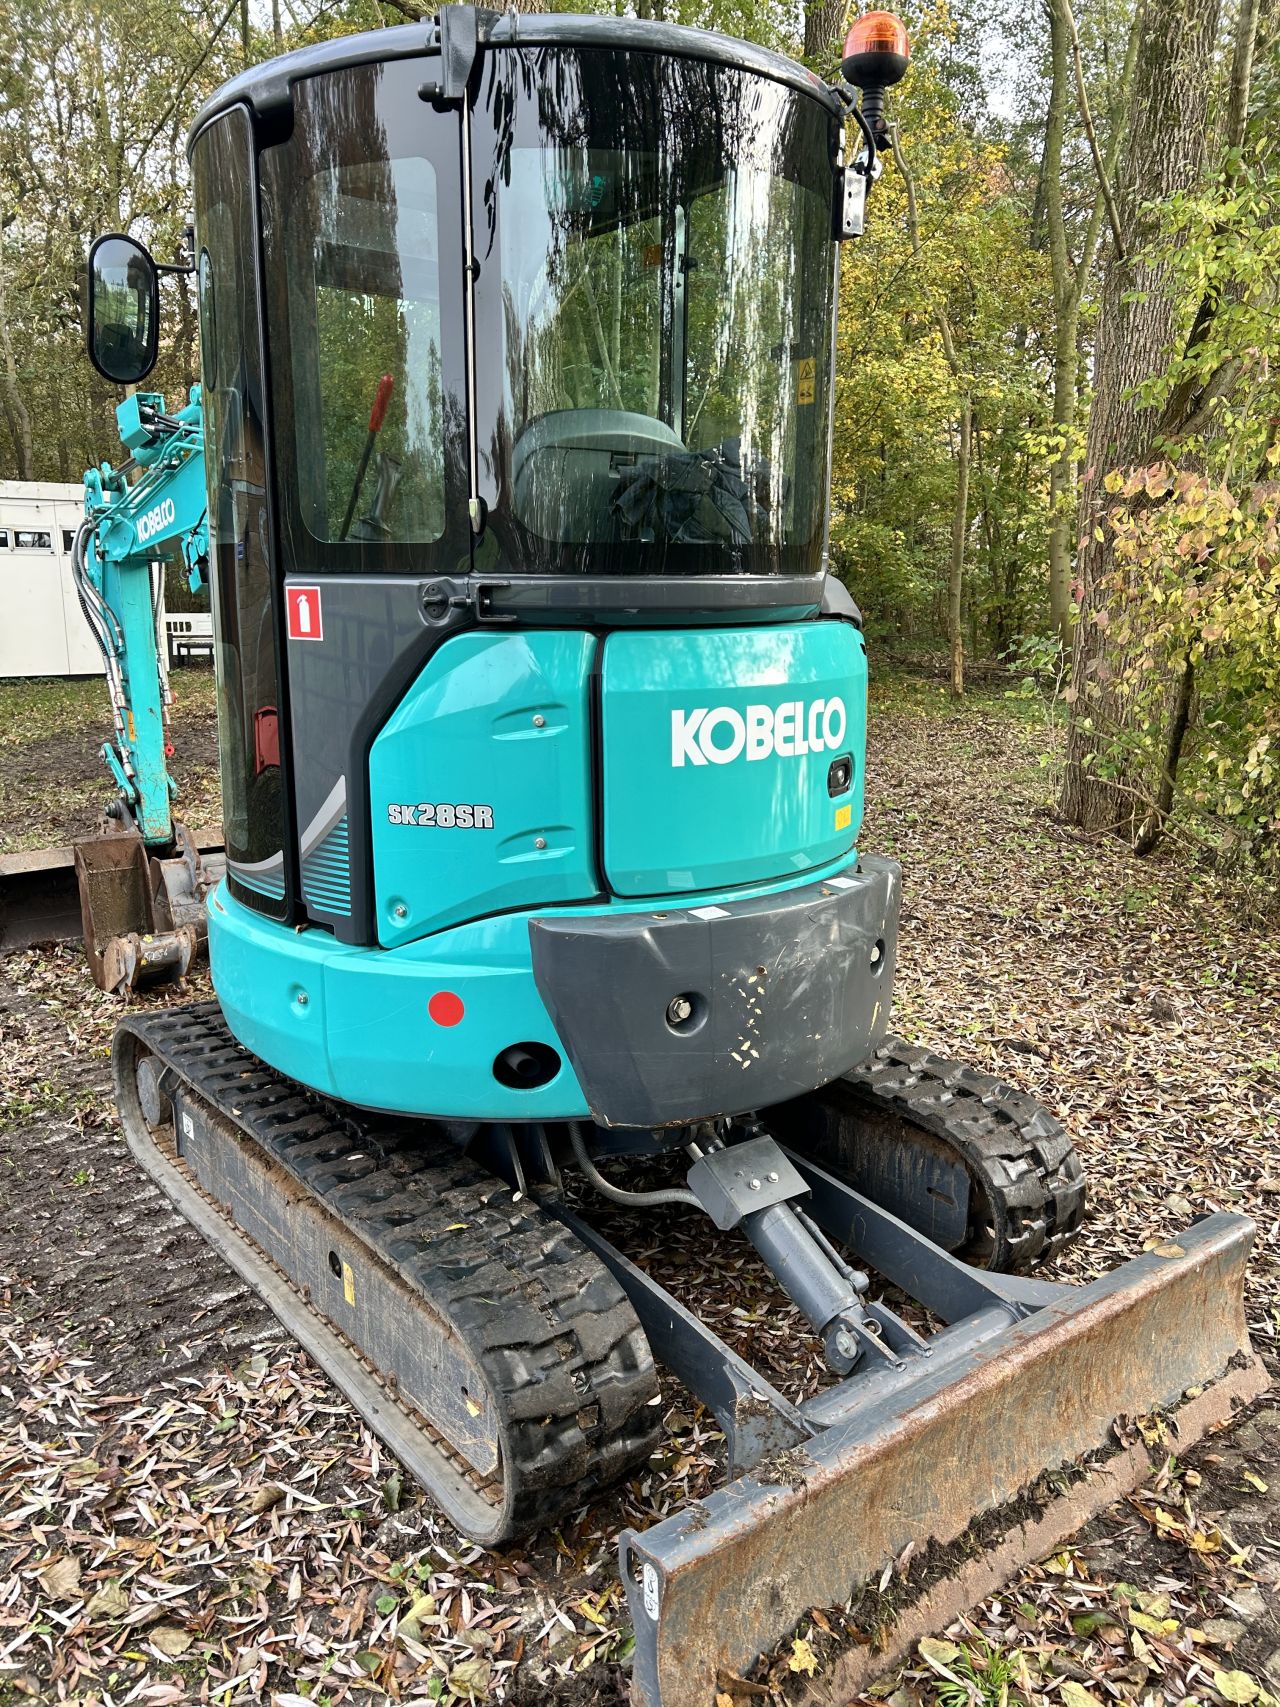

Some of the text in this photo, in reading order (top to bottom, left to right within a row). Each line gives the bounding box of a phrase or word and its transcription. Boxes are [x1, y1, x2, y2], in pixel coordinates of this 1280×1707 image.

[136, 497, 175, 544] KOBELCO
[671, 696, 847, 768] KOBELCO
[388, 803, 494, 829] SK28SR
